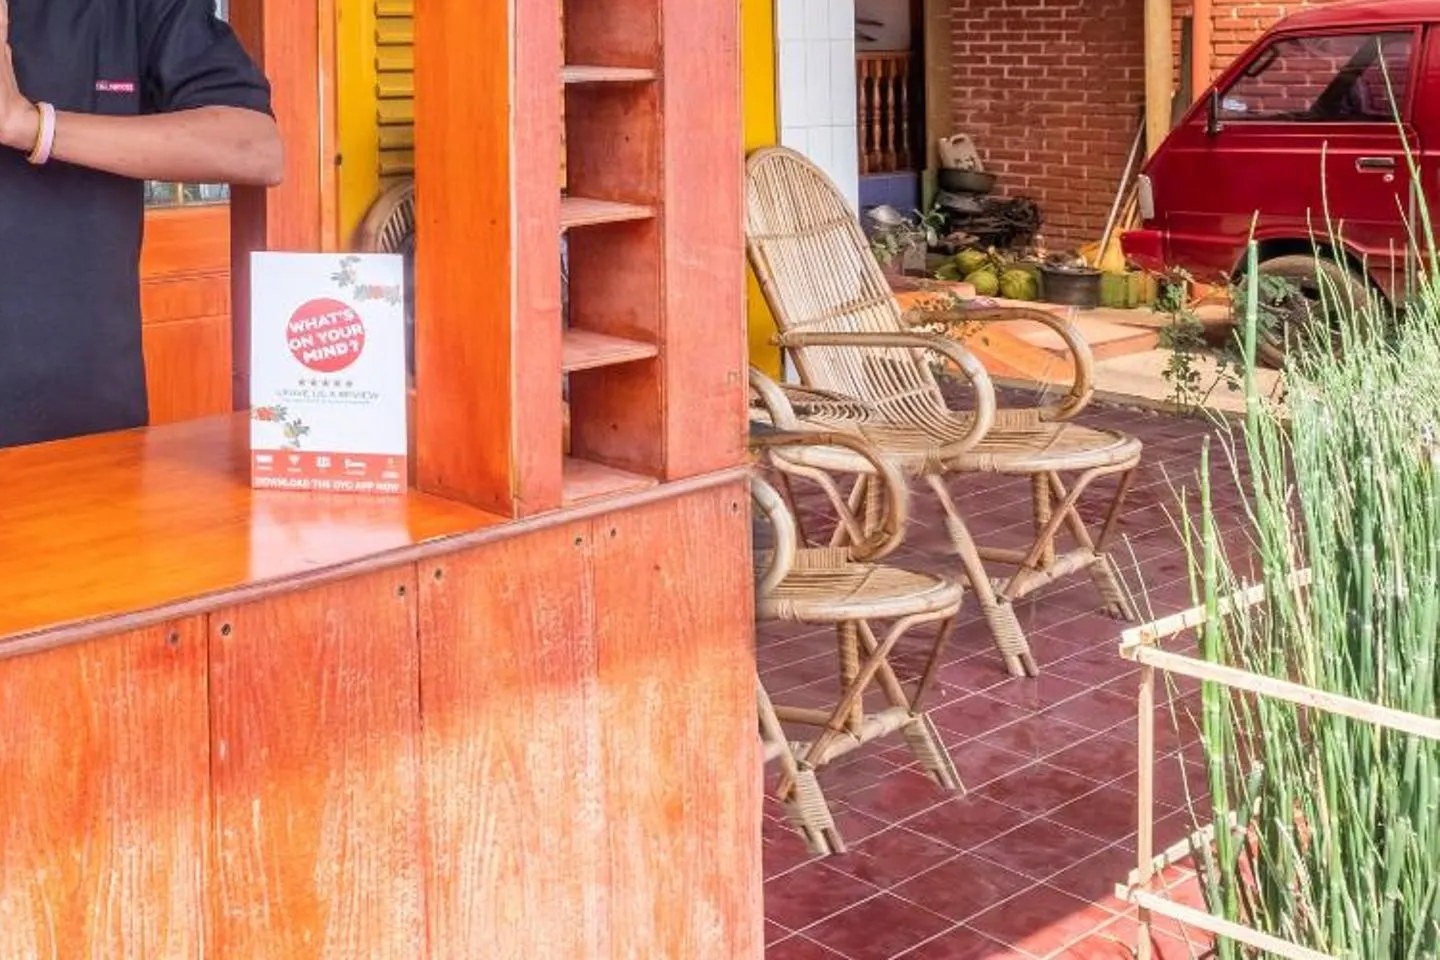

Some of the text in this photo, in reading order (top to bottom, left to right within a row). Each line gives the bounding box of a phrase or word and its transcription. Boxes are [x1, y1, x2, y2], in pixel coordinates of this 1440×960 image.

[289, 308, 356, 333] WHAT'S
[289, 323, 364, 351] ON YOUR
[302, 340, 360, 363] MIND?
